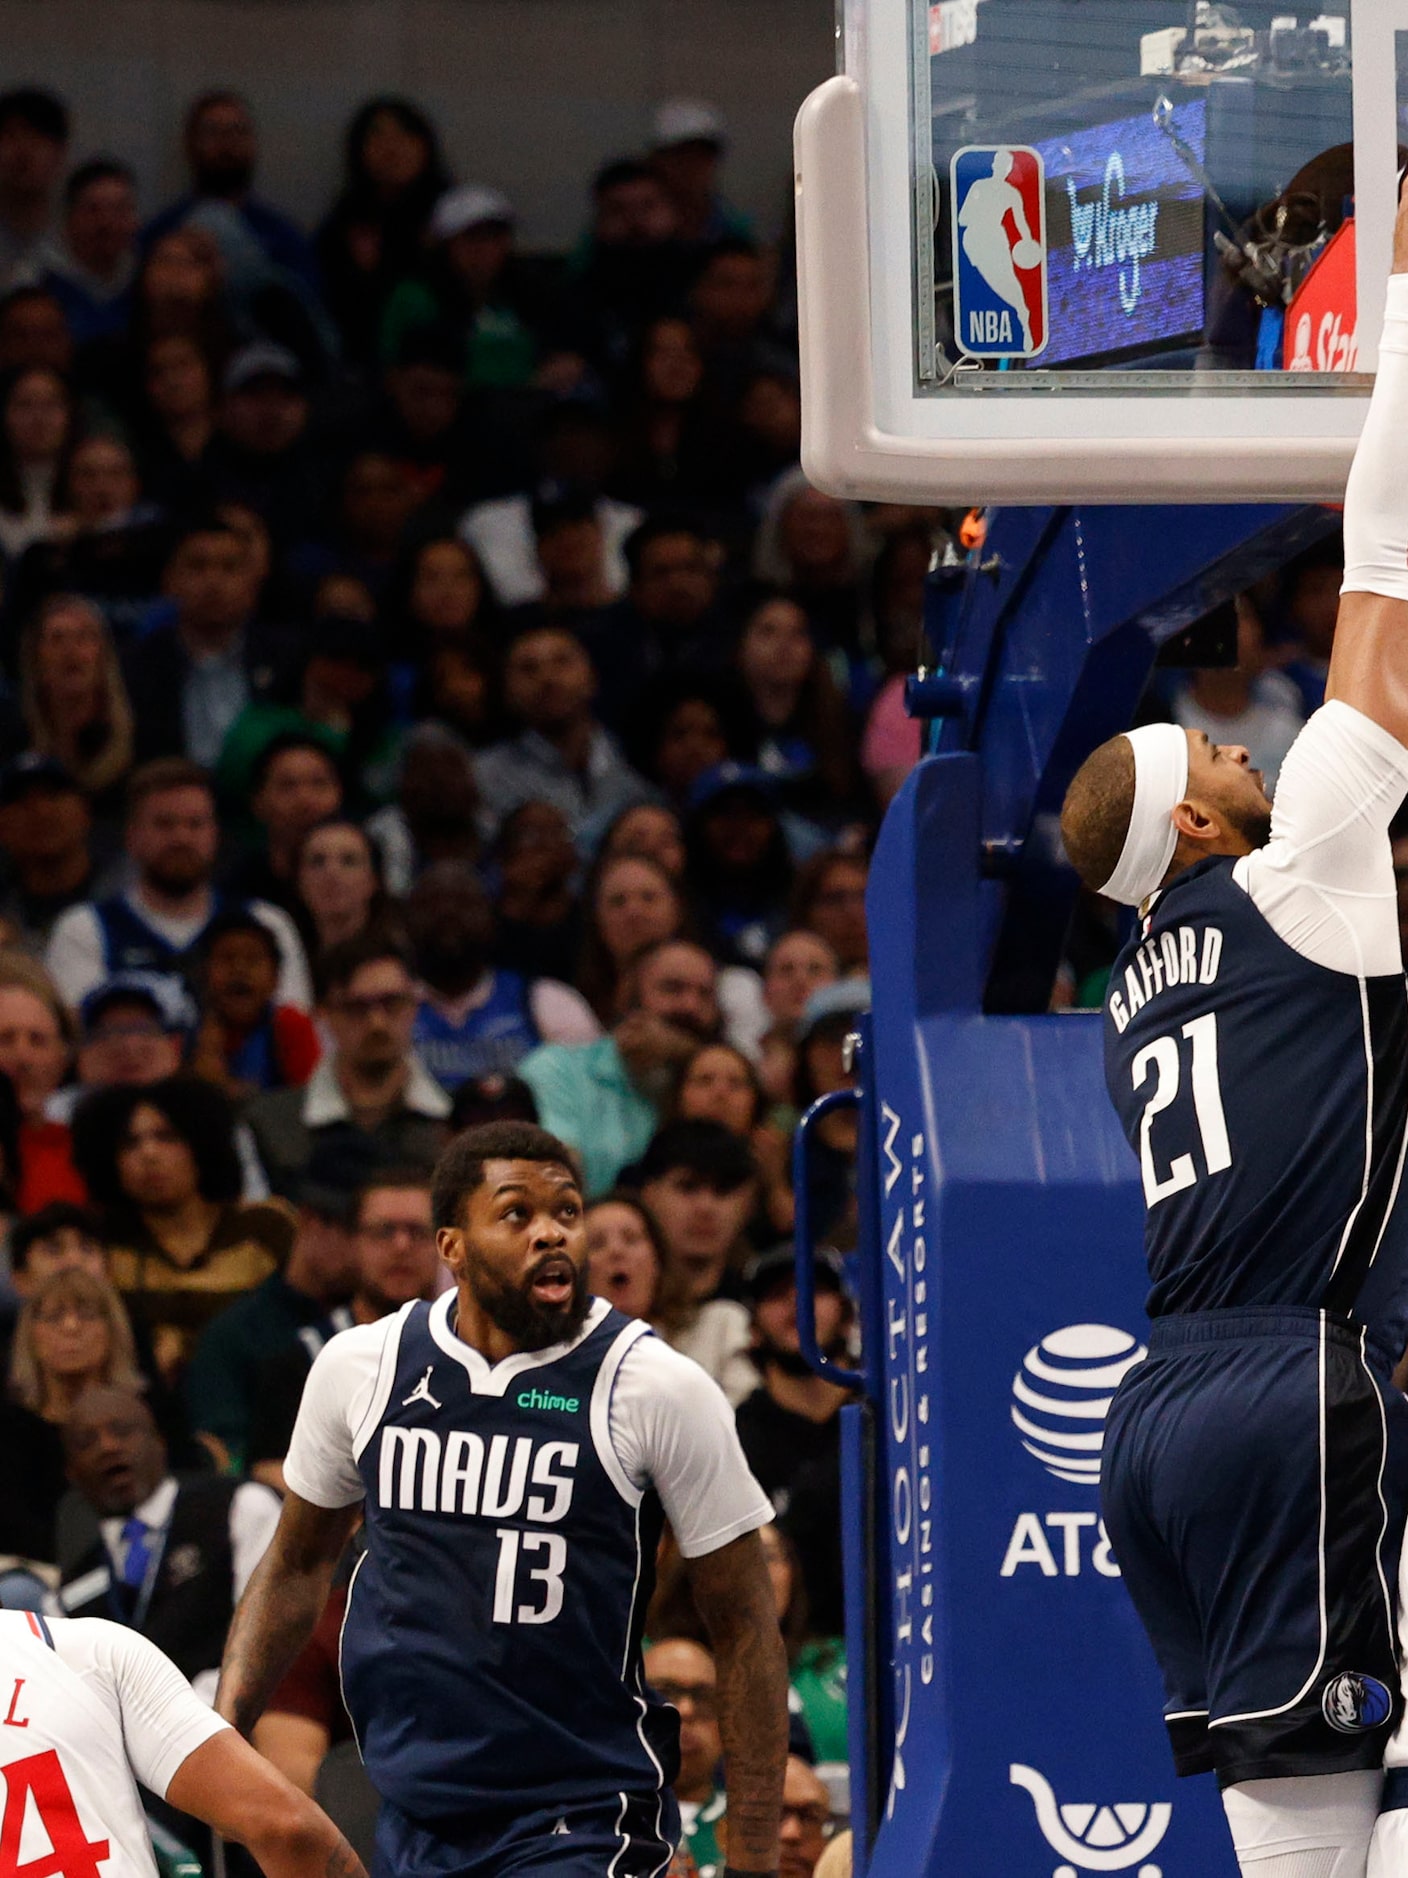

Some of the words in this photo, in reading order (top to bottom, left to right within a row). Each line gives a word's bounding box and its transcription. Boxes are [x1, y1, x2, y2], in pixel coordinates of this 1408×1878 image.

[969, 310, 1013, 343] NBA
[1109, 926, 1223, 1034] GAFFORD
[1131, 1012, 1233, 1209] 21
[911, 1133, 928, 1374] RESORTS
[517, 1389, 580, 1413] chime
[378, 1425, 580, 1523] MAVS
[493, 1528, 567, 1624] 13
[917, 1444, 934, 1685] CASINOS
